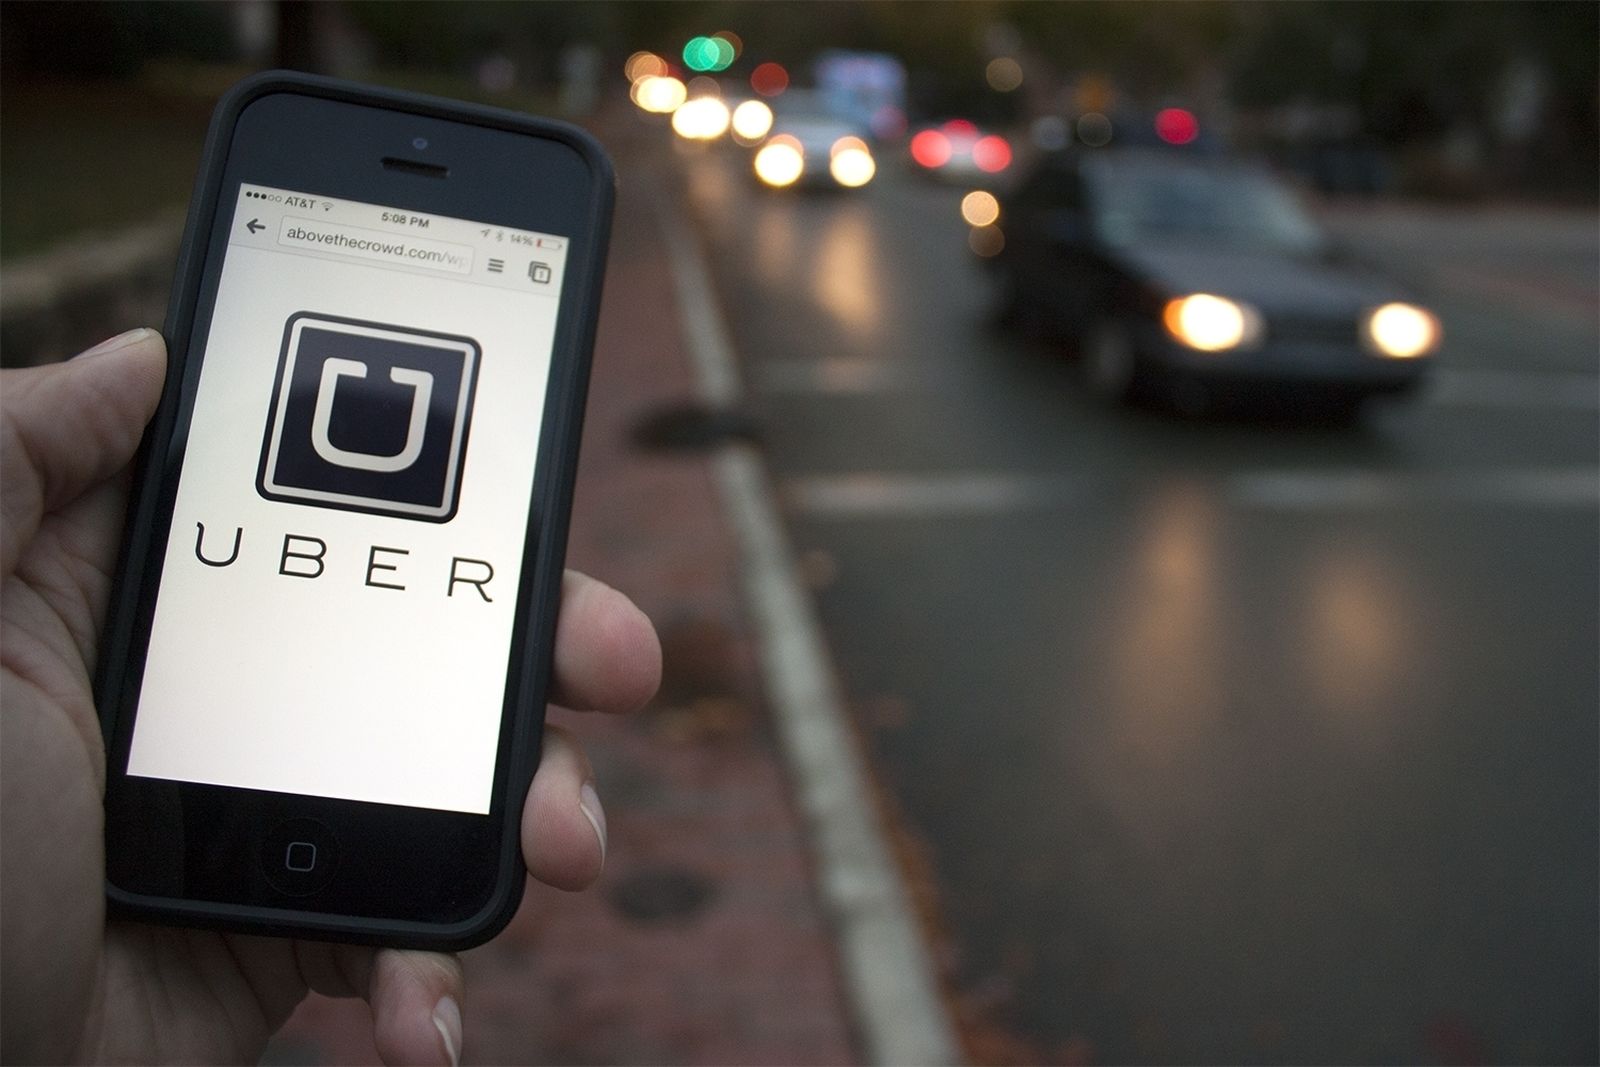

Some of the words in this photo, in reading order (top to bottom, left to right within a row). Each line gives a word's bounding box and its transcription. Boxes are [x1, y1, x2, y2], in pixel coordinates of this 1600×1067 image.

[284, 196, 316, 209] AT&T
[381, 211, 407, 224] 5:08
[409, 216, 430, 228] PM
[510, 234, 533, 247] 14%
[195, 521, 494, 602] UBER
